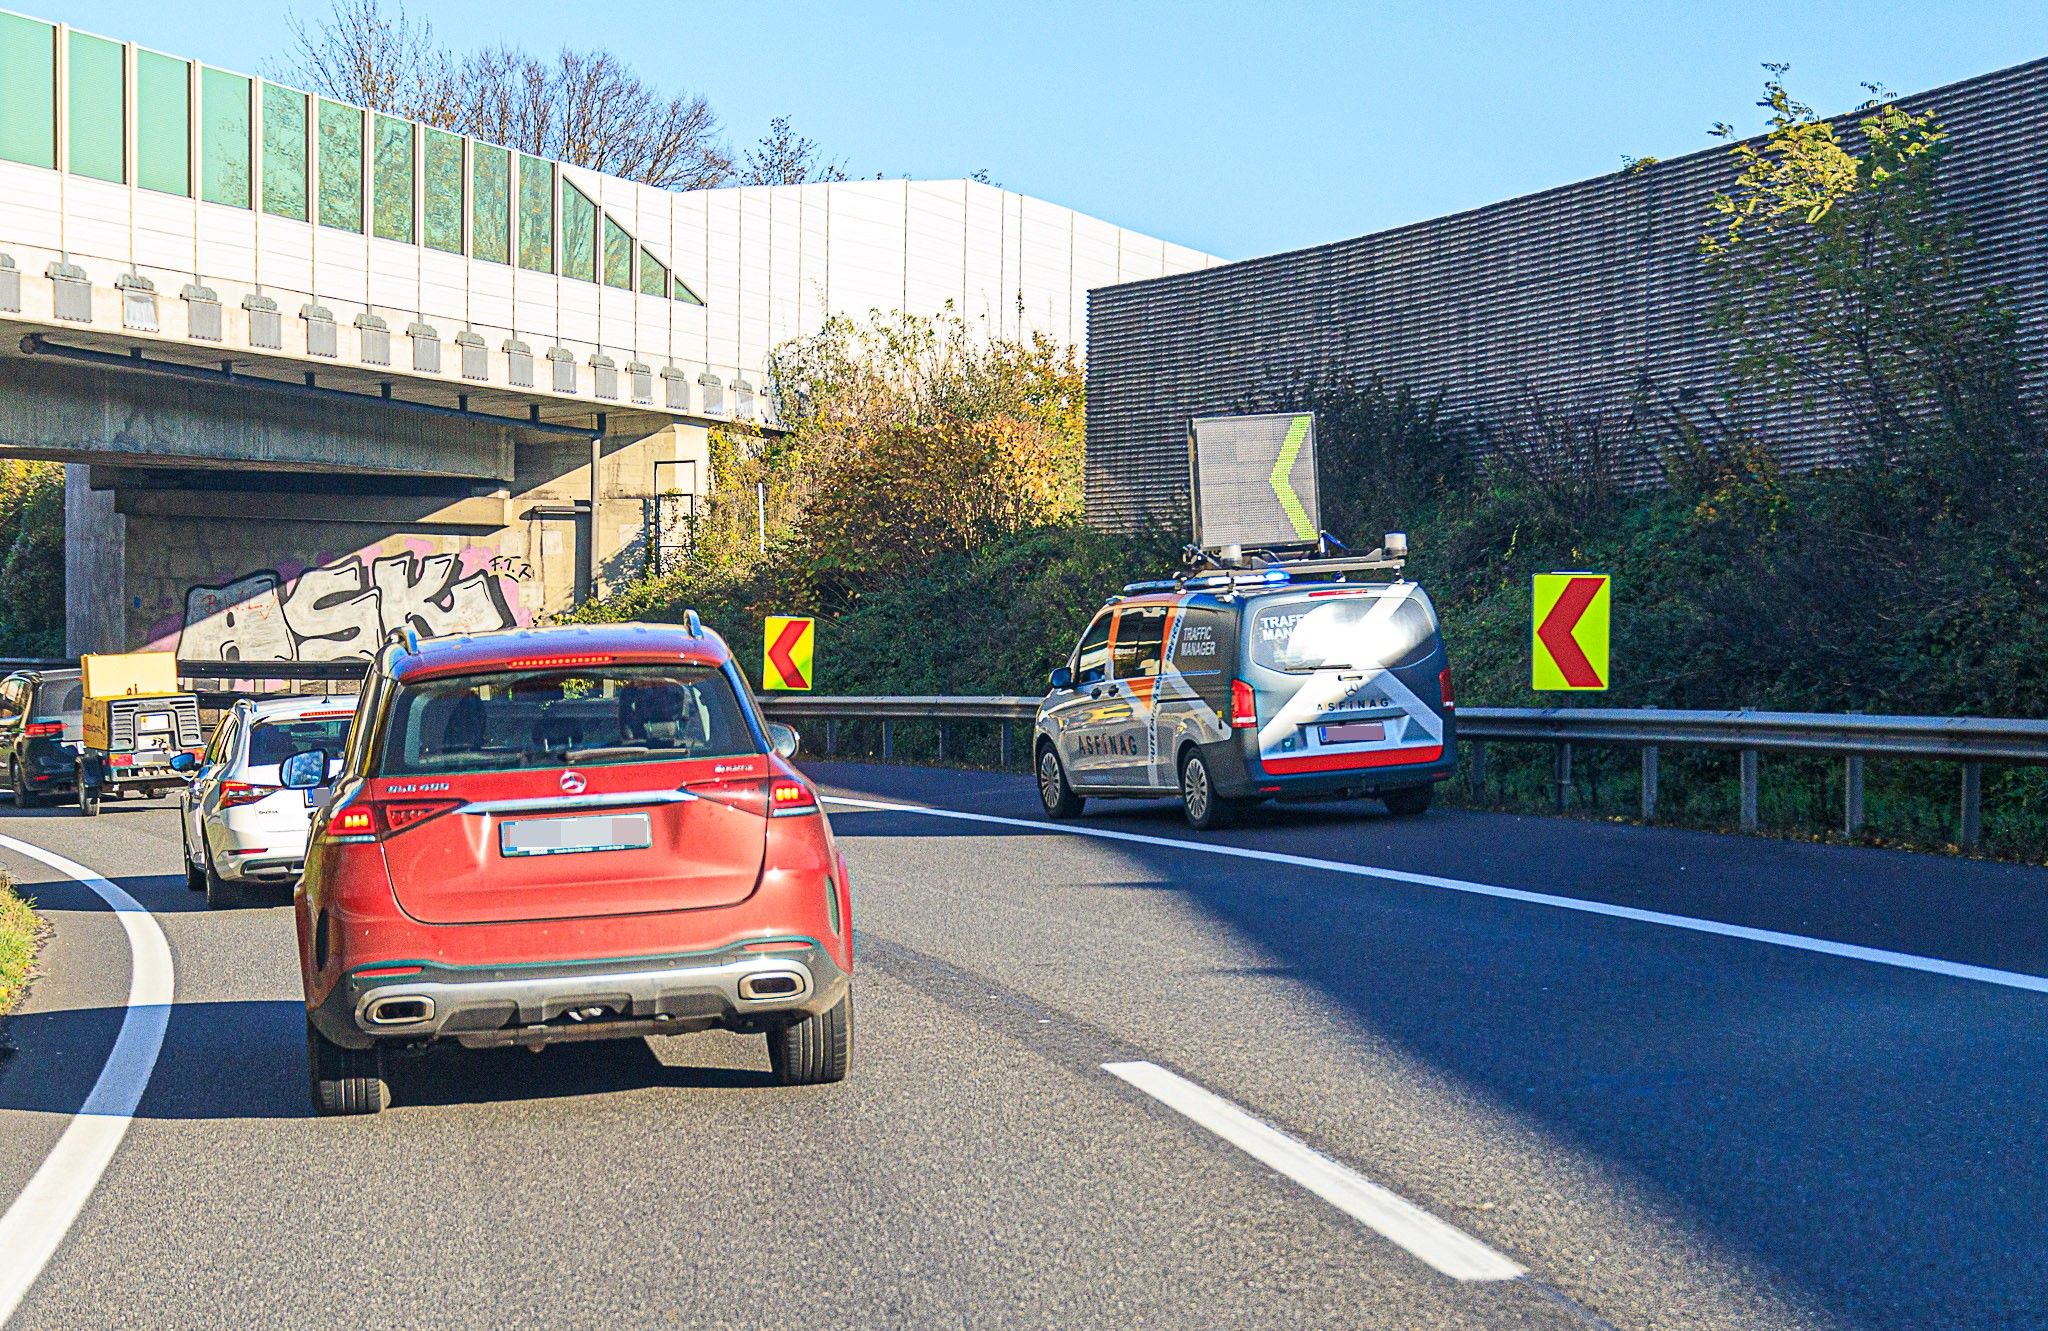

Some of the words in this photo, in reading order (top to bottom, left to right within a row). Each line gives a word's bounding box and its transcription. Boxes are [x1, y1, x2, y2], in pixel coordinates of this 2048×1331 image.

[1260, 614, 1304, 629] TRAFF
[1183, 626, 1212, 641] TRAFFIC
[1180, 641, 1216, 656] MANAGER
